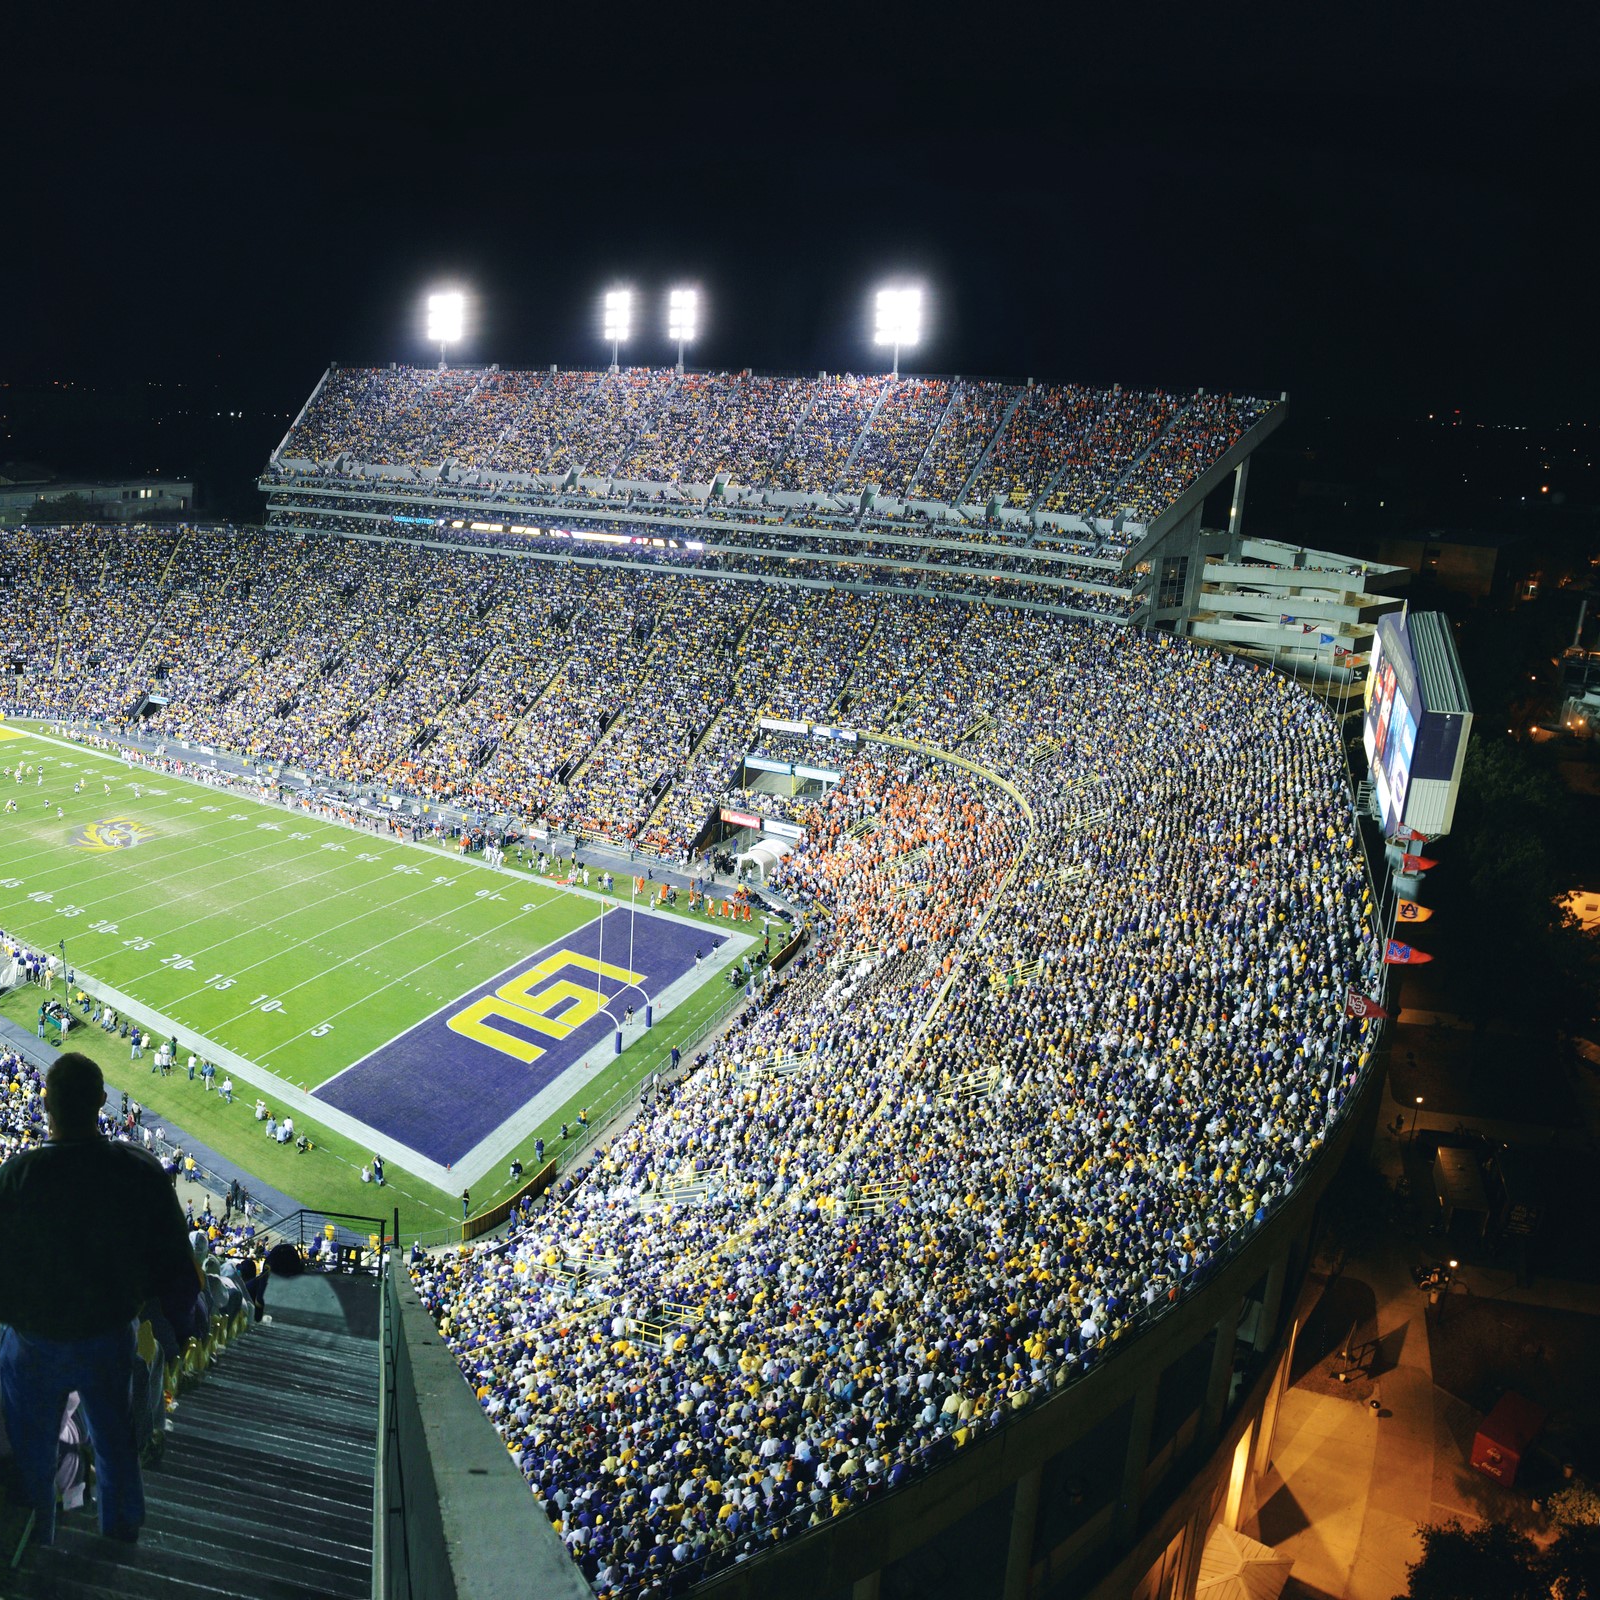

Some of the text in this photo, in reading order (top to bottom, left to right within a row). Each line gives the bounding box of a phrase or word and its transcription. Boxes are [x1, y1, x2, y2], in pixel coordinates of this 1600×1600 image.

[355, 852, 383, 863] 25
[392, 864, 416, 875] 20
[431, 876, 457, 887] 15
[27, 890, 54, 903] 40
[474, 889, 505, 901] 10
[55, 904, 86, 918] 35
[519, 903, 536, 912] 5
[87, 918, 120, 934] 30
[122, 936, 156, 951] 25
[1387, 941, 1412, 959] M
[159, 953, 194, 970] 20
[204, 973, 238, 991] 15
[249, 994, 284, 1013] 10
[446, 948, 649, 1065] LSU
[1348, 993, 1367, 1016] MSU
[310, 1023, 335, 1038] 5
